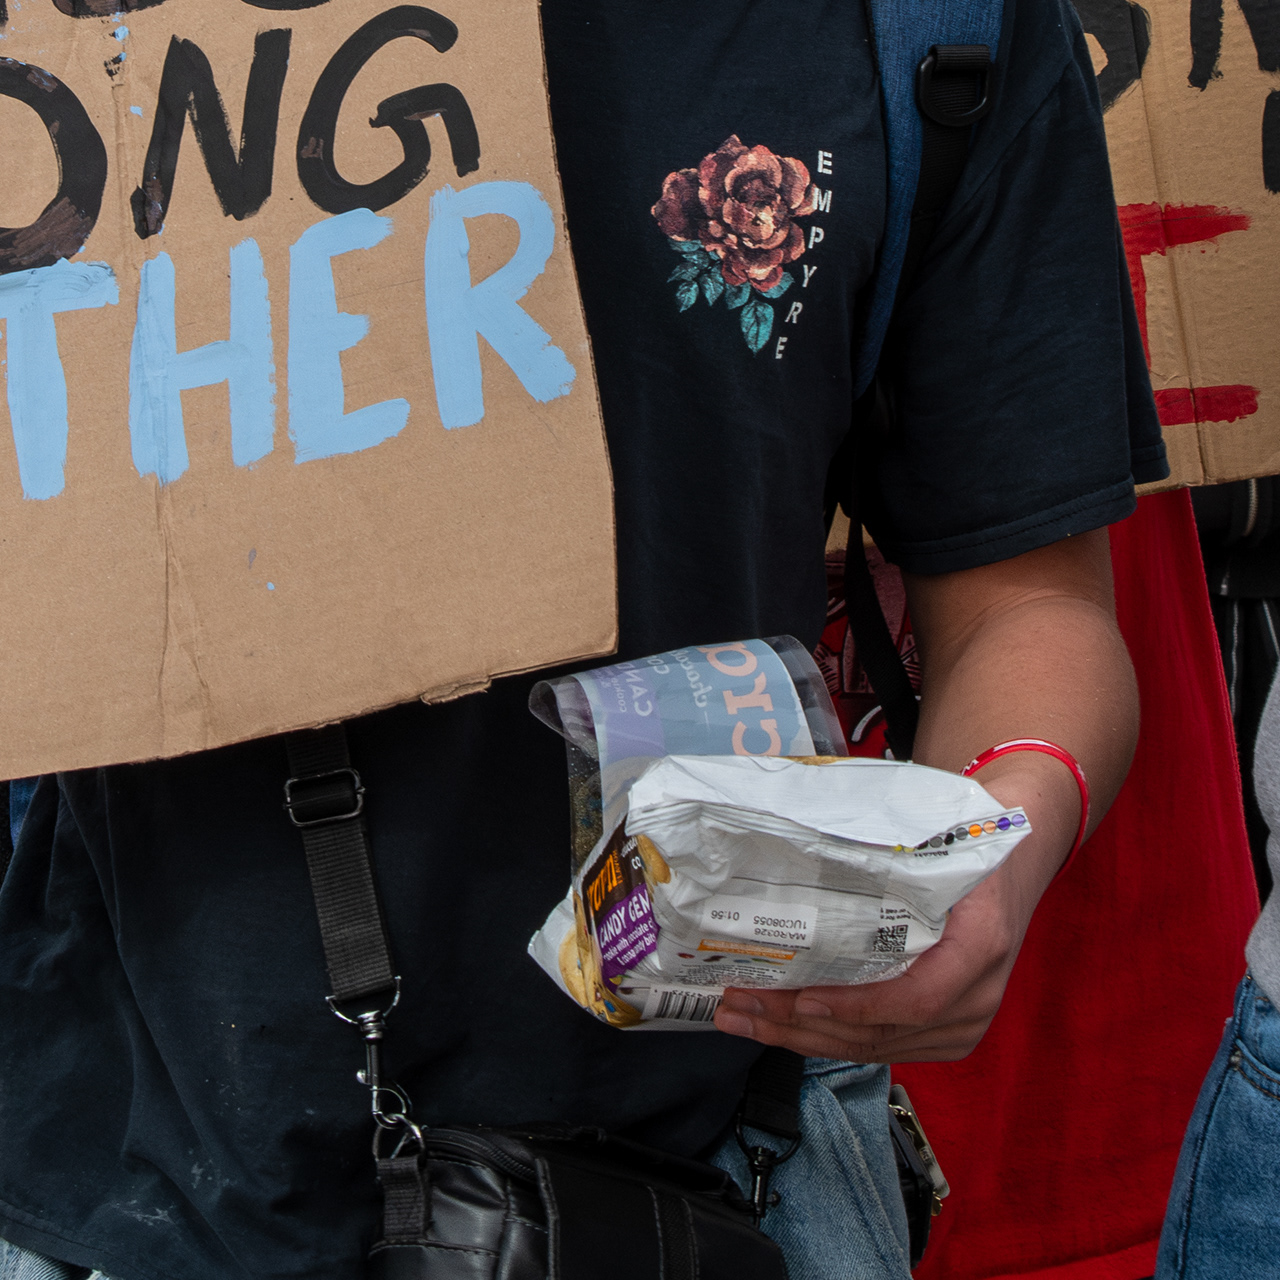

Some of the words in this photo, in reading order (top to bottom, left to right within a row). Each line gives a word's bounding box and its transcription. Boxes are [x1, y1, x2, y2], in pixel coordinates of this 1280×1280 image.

[773, 149, 834, 361] EMPYRE
[710, 910, 740, 921] 01:56
[754, 926, 806, 942] MAR0326
